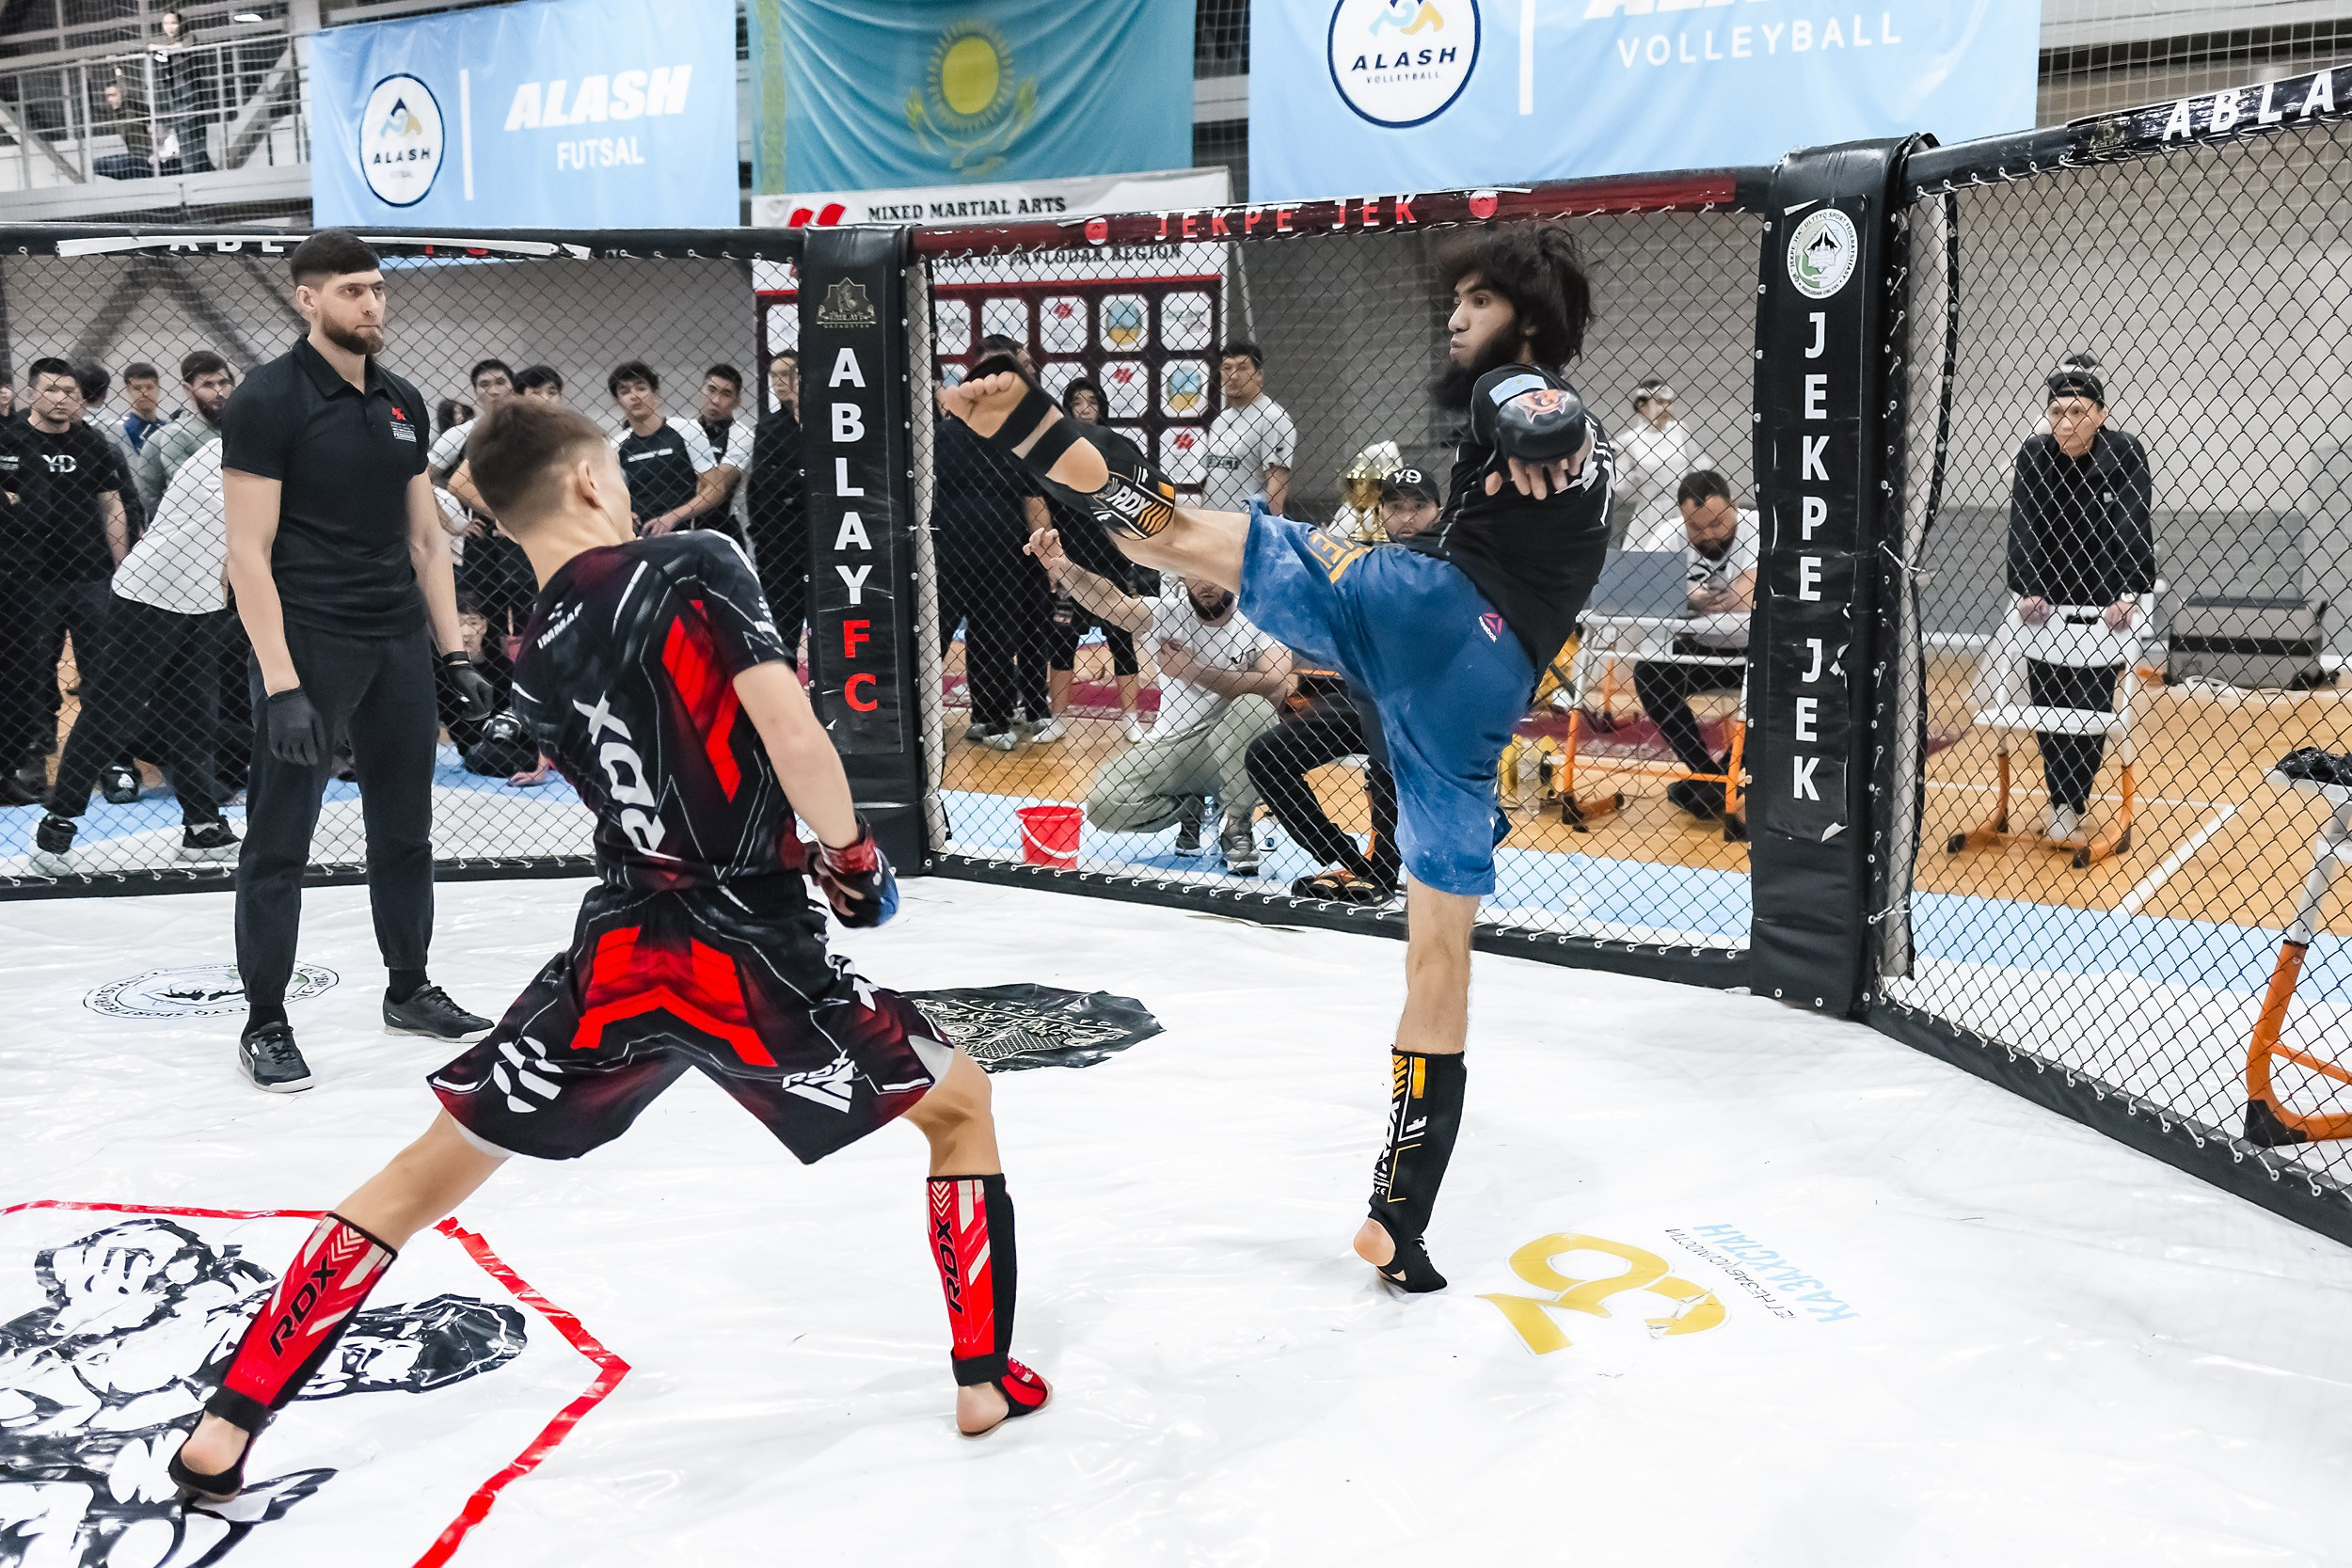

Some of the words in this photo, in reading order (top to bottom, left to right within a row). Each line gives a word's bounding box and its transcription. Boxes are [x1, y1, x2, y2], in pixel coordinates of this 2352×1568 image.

[1351, 46, 1457, 71] ALASH
[1617, 12, 1902, 69] VOLLEYBALL
[503, 64, 693, 132] ALASH
[1366, 71, 1440, 84] VOLLEYBALL
[2162, 71, 2336, 141] ABLA
[373, 149, 432, 165] ALASH
[556, 135, 646, 171] FUTSAL
[867, 204, 924, 221] MIXED
[930, 199, 1011, 218] MARTIAL
[1018, 197, 1068, 214] ARTS
[1154, 202, 1303, 242] JEKPE
[1331, 193, 1418, 230] JEK
[828, 347, 873, 605] ABLAY
[1799, 312, 1828, 601] JEKPE
[1104, 485, 1152, 519] RDX
[537, 601, 583, 650] IMMAF
[842, 619, 878, 712] FC
[1792, 639, 1823, 801] JEK
[782, 1049, 852, 1089] RDX
[934, 1212, 964, 1315] RDX
[1692, 1224, 1862, 1323] КАЗАХСТАН
[269, 1252, 340, 1358] RDX
